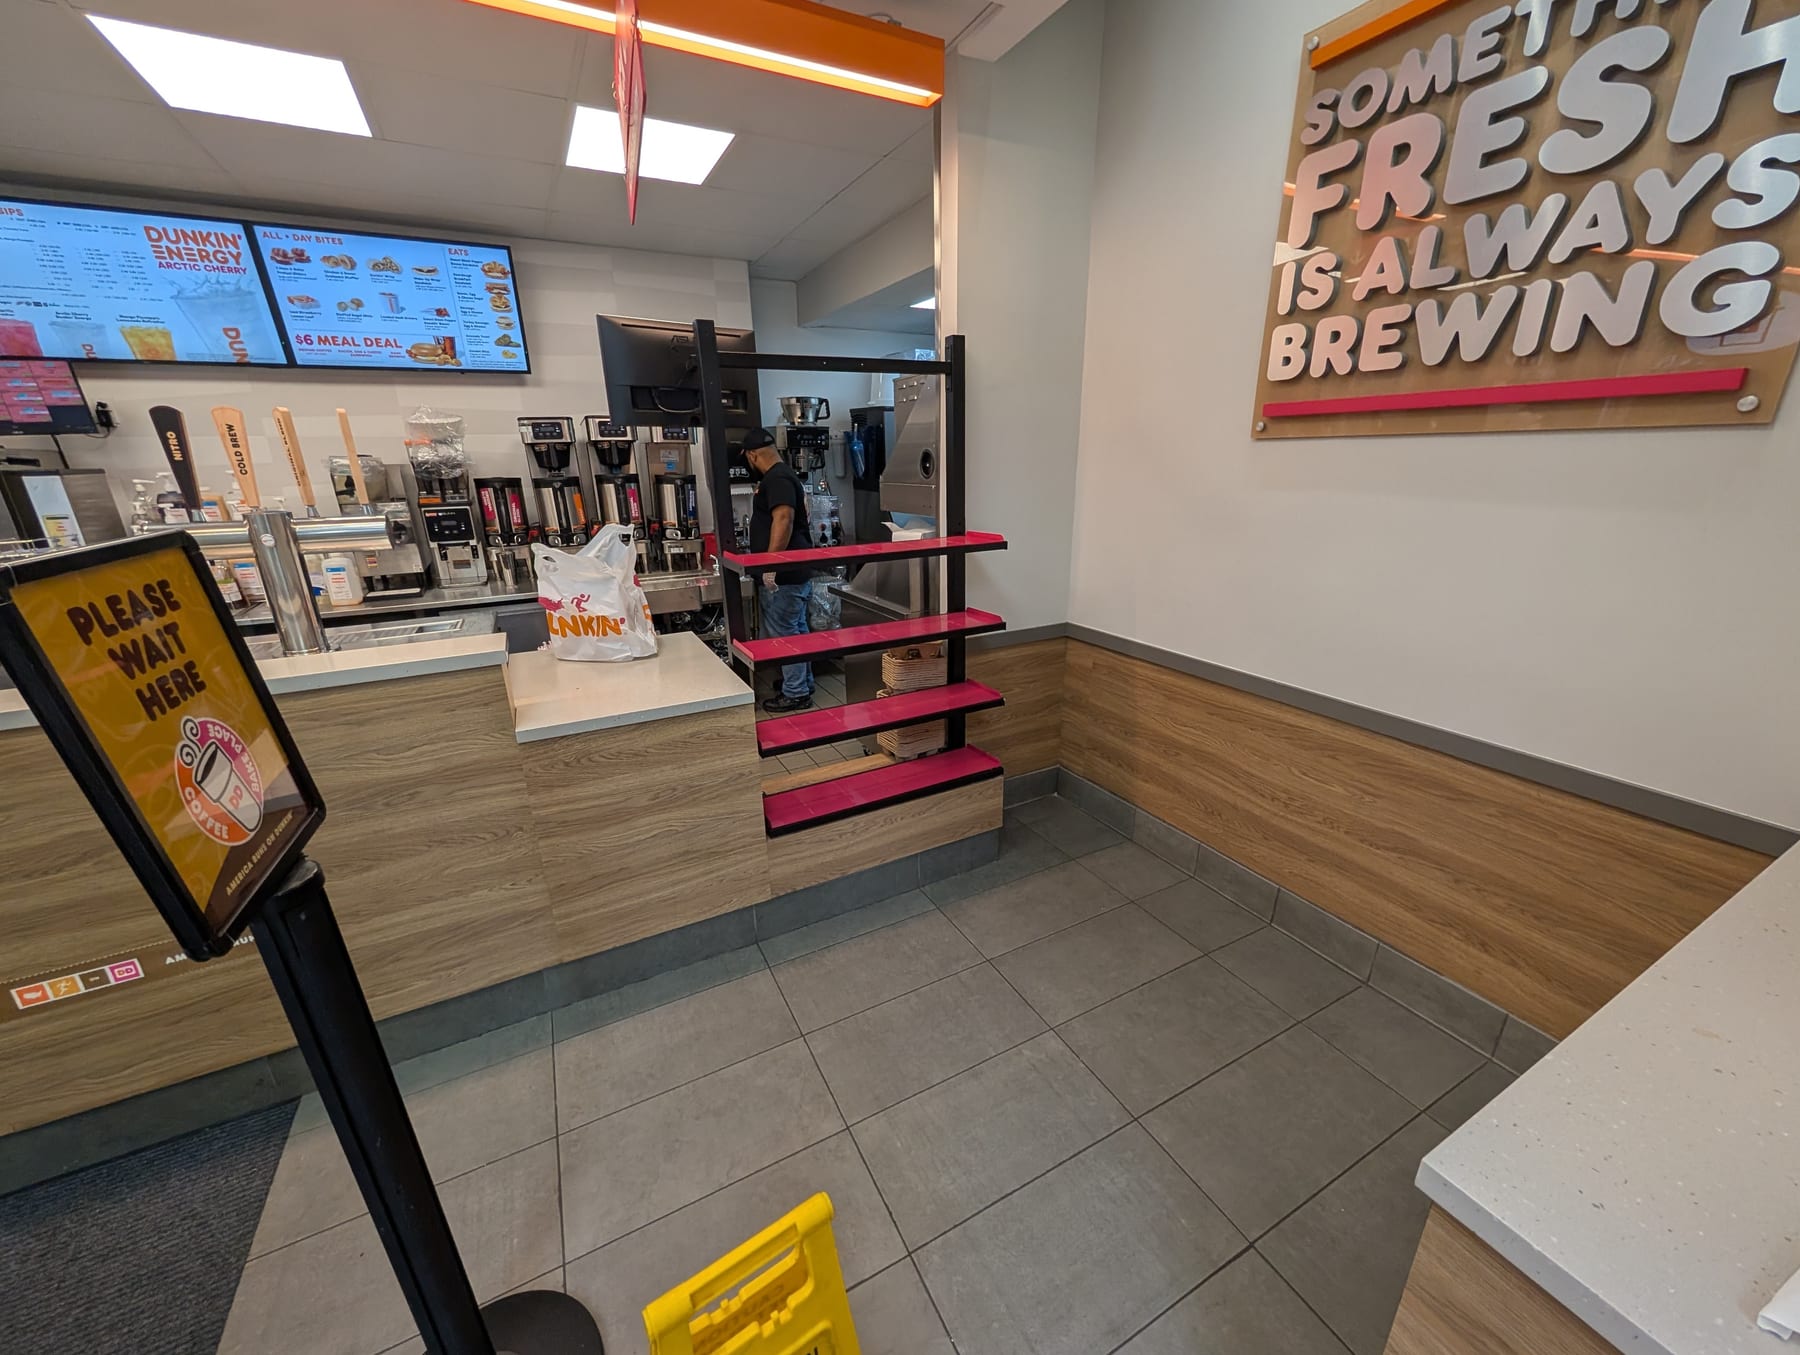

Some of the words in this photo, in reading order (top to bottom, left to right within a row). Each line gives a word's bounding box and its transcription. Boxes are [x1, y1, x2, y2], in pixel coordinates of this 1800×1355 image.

[1301, 0, 1672, 145] SOMET
[1288, 0, 1800, 250] FRESH
[144, 225, 243, 250] DUNKIN'
[262, 230, 282, 241] ALL
[293, 233, 312, 243] DAY
[315, 235, 344, 246] BITES
[1277, 252, 1340, 316] IS
[1352, 133, 1800, 302] ALWAYS
[150, 244, 243, 266] ENERGY
[158, 261, 201, 272] ARCTIC
[203, 265, 247, 275] CHERRY
[448, 248, 470, 257] EATS
[1266, 241, 1781, 382] BREWING
[295, 334, 314, 346] $6
[317, 335, 361, 347] MEAL
[363, 337, 403, 349] DEAL
[166, 431, 183, 461] NITRO
[225, 423, 240, 450] BREW
[234, 450, 248, 476] COLD
[66, 578, 182, 646] PLEASE
[107, 621, 189, 681] WAIT
[135, 660, 207, 722] HERE
[207, 723, 243, 753] PLACE
[242, 752, 260, 793] BAKE
[185, 786, 229, 839] COFFEE
[226, 861, 253, 896] AMERICA
[252, 842, 268, 864] RUNS
[266, 833, 276, 846] ON
